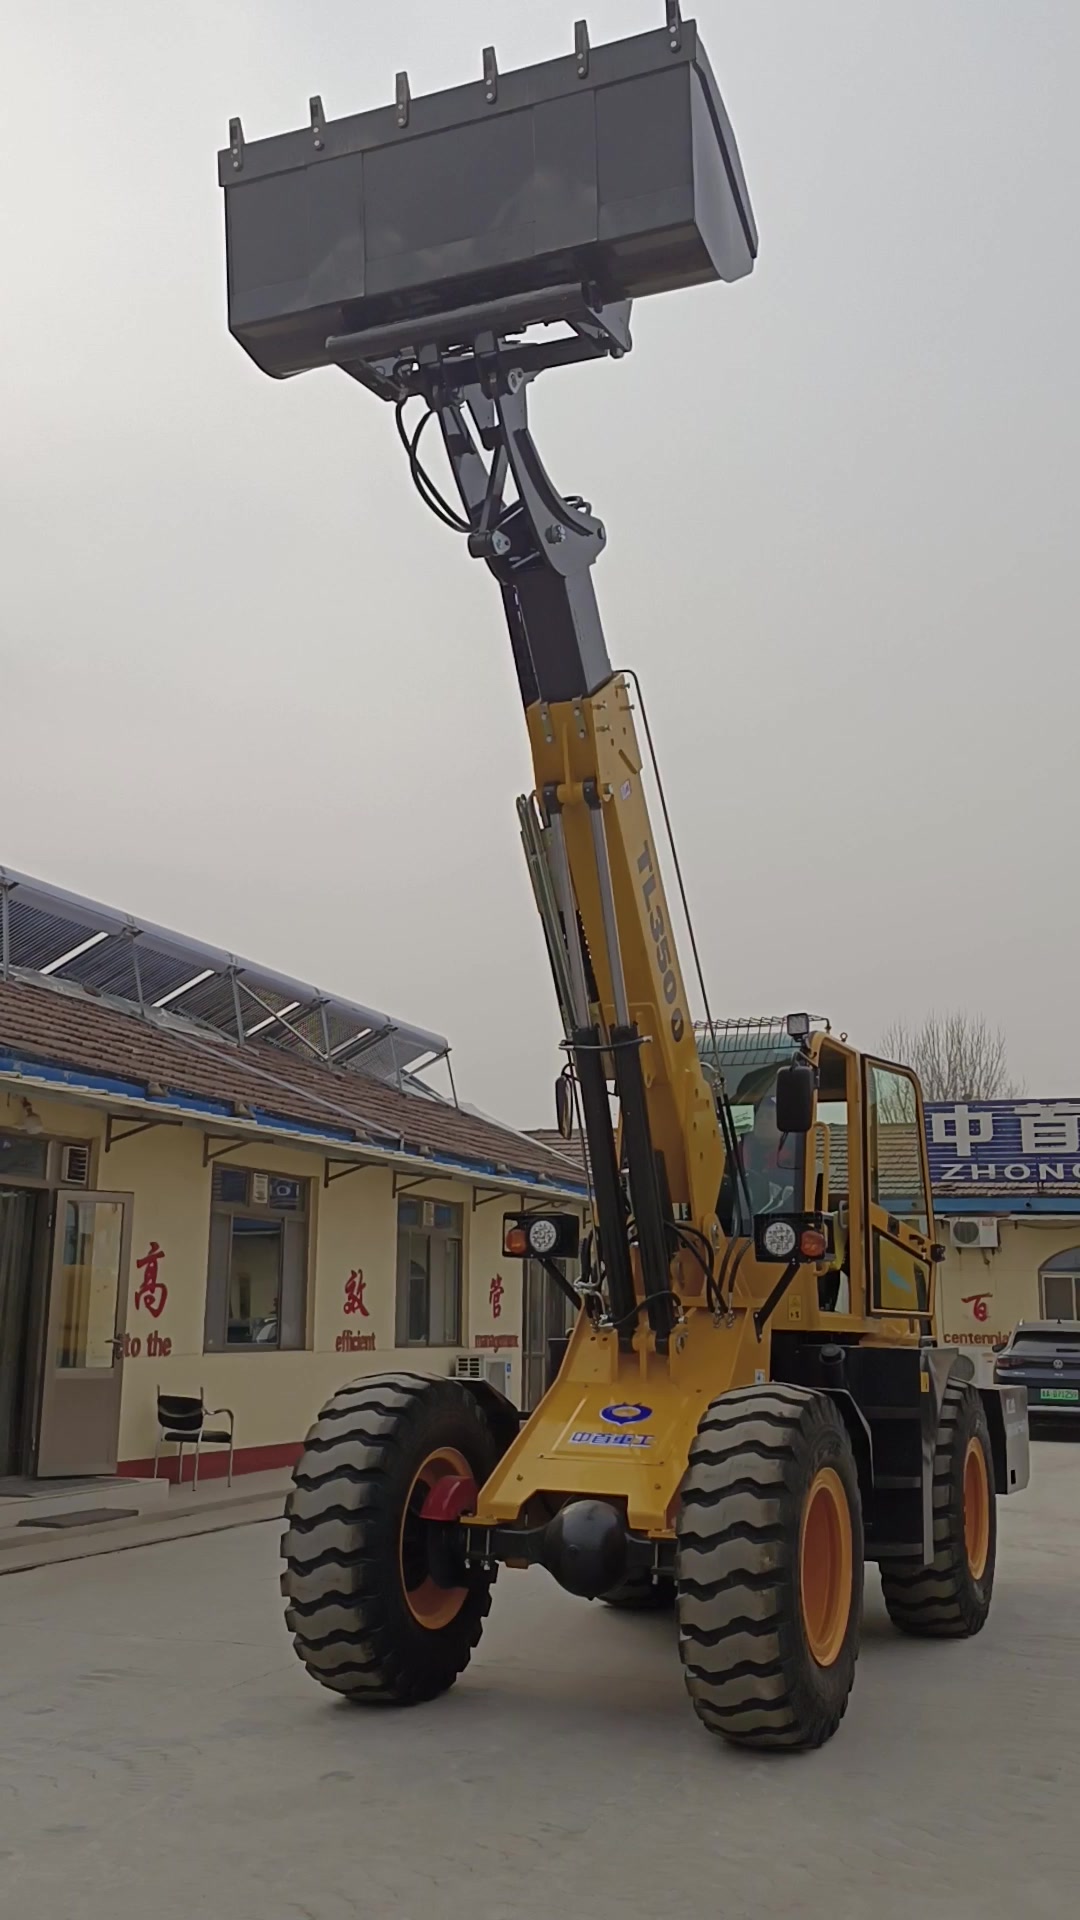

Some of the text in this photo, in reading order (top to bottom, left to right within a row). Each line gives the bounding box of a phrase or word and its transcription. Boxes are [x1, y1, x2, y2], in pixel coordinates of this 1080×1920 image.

[637, 840, 684, 1042] TL3500
[135, 1241, 167, 1318] 高
[123, 1332, 141, 1357] to
[147, 1330, 172, 1357] the
[335, 1330, 376, 1352] efficient
